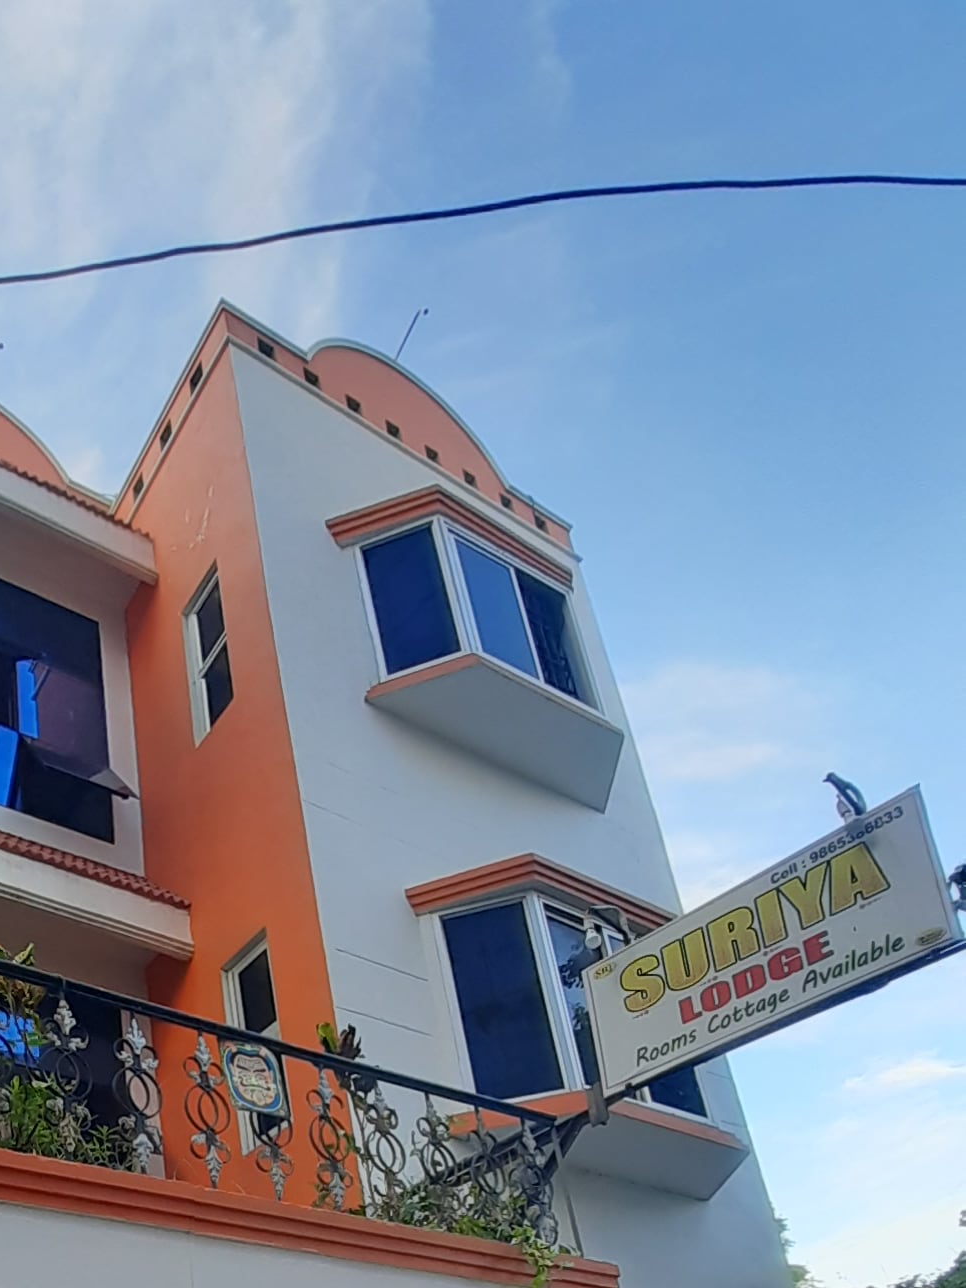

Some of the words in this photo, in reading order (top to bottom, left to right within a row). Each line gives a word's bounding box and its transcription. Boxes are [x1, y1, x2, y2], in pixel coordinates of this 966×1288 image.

[620, 841, 890, 1014] SURIYA
[678, 930, 835, 1025] LODGE
[636, 1030, 697, 1067] Rooms
[707, 988, 791, 1033] Cottage
[802, 933, 906, 993] Available
